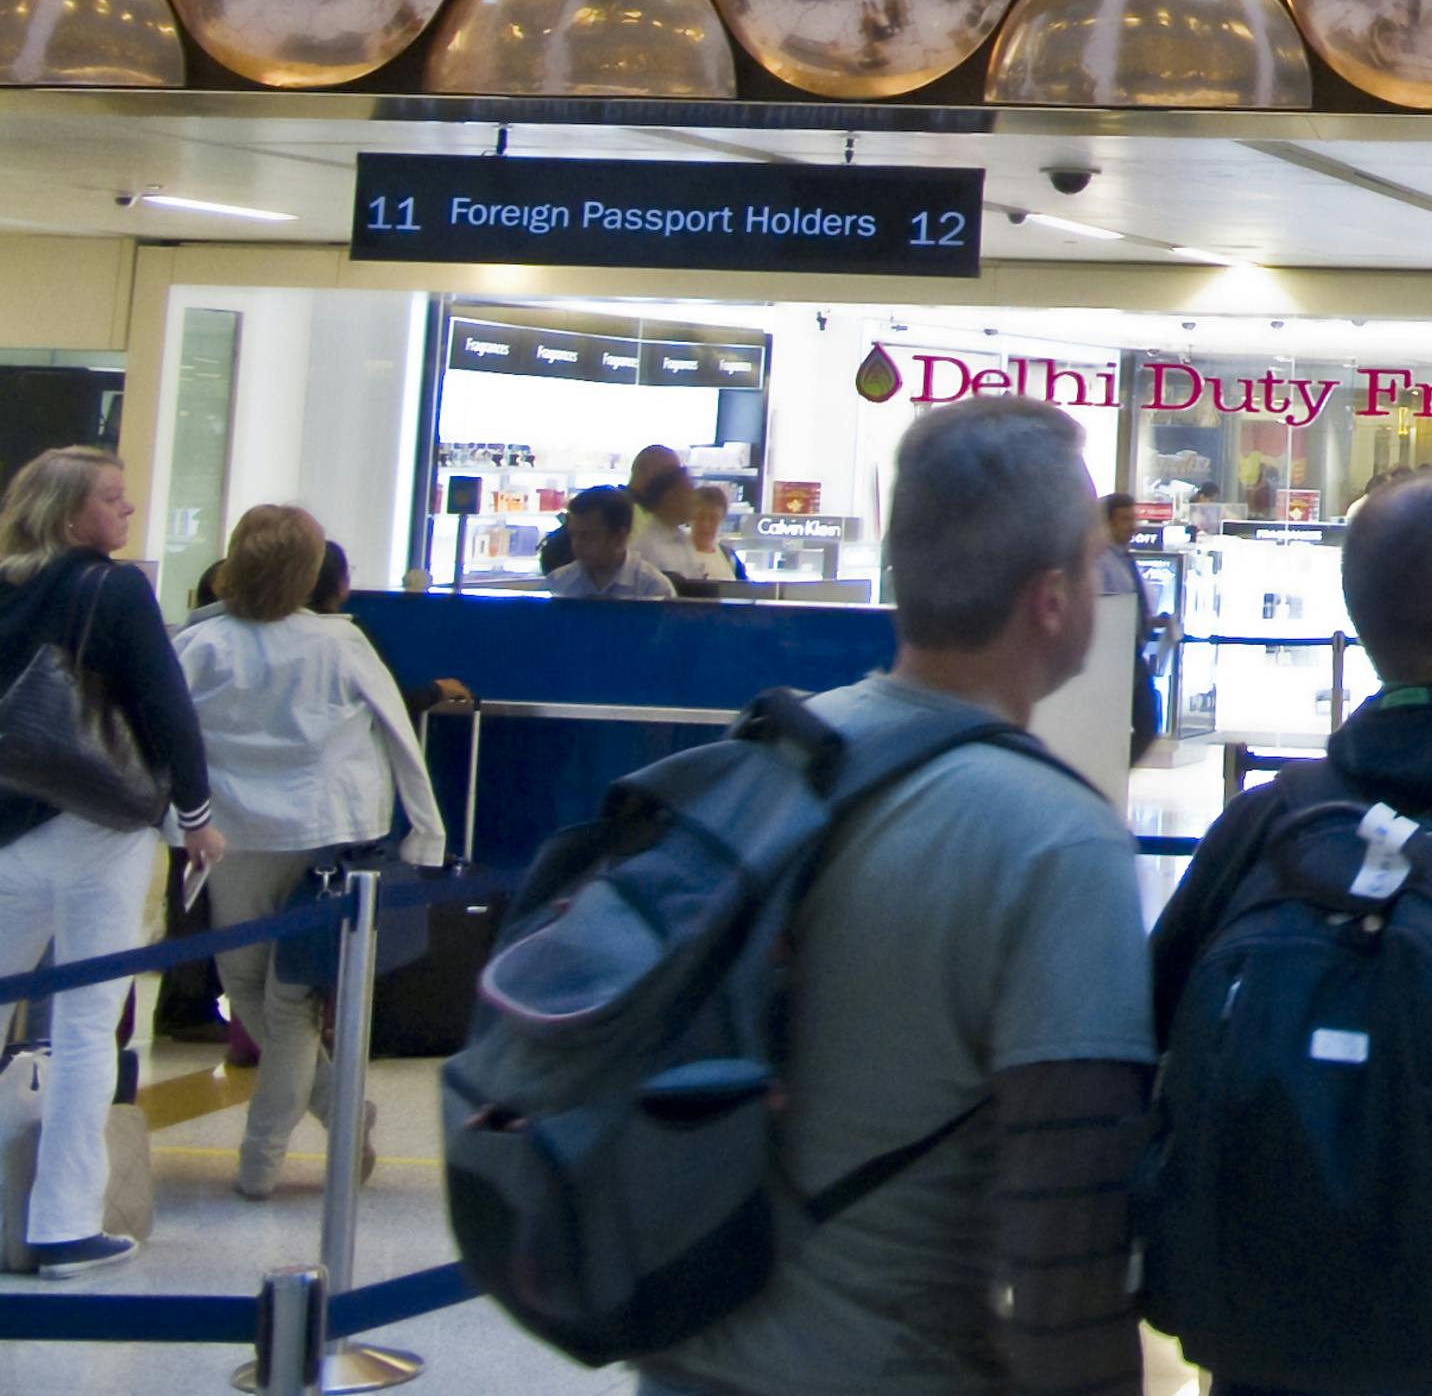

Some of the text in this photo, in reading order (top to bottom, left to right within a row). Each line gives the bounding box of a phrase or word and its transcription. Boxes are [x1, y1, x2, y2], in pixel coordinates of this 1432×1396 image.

[367, 196, 966, 246] 11 Foreign Passport Holders 12
[910, 355, 1121, 408] Delhi
[1141, 362, 1340, 427] Duty
[757, 518, 841, 537] Calvin Klein
